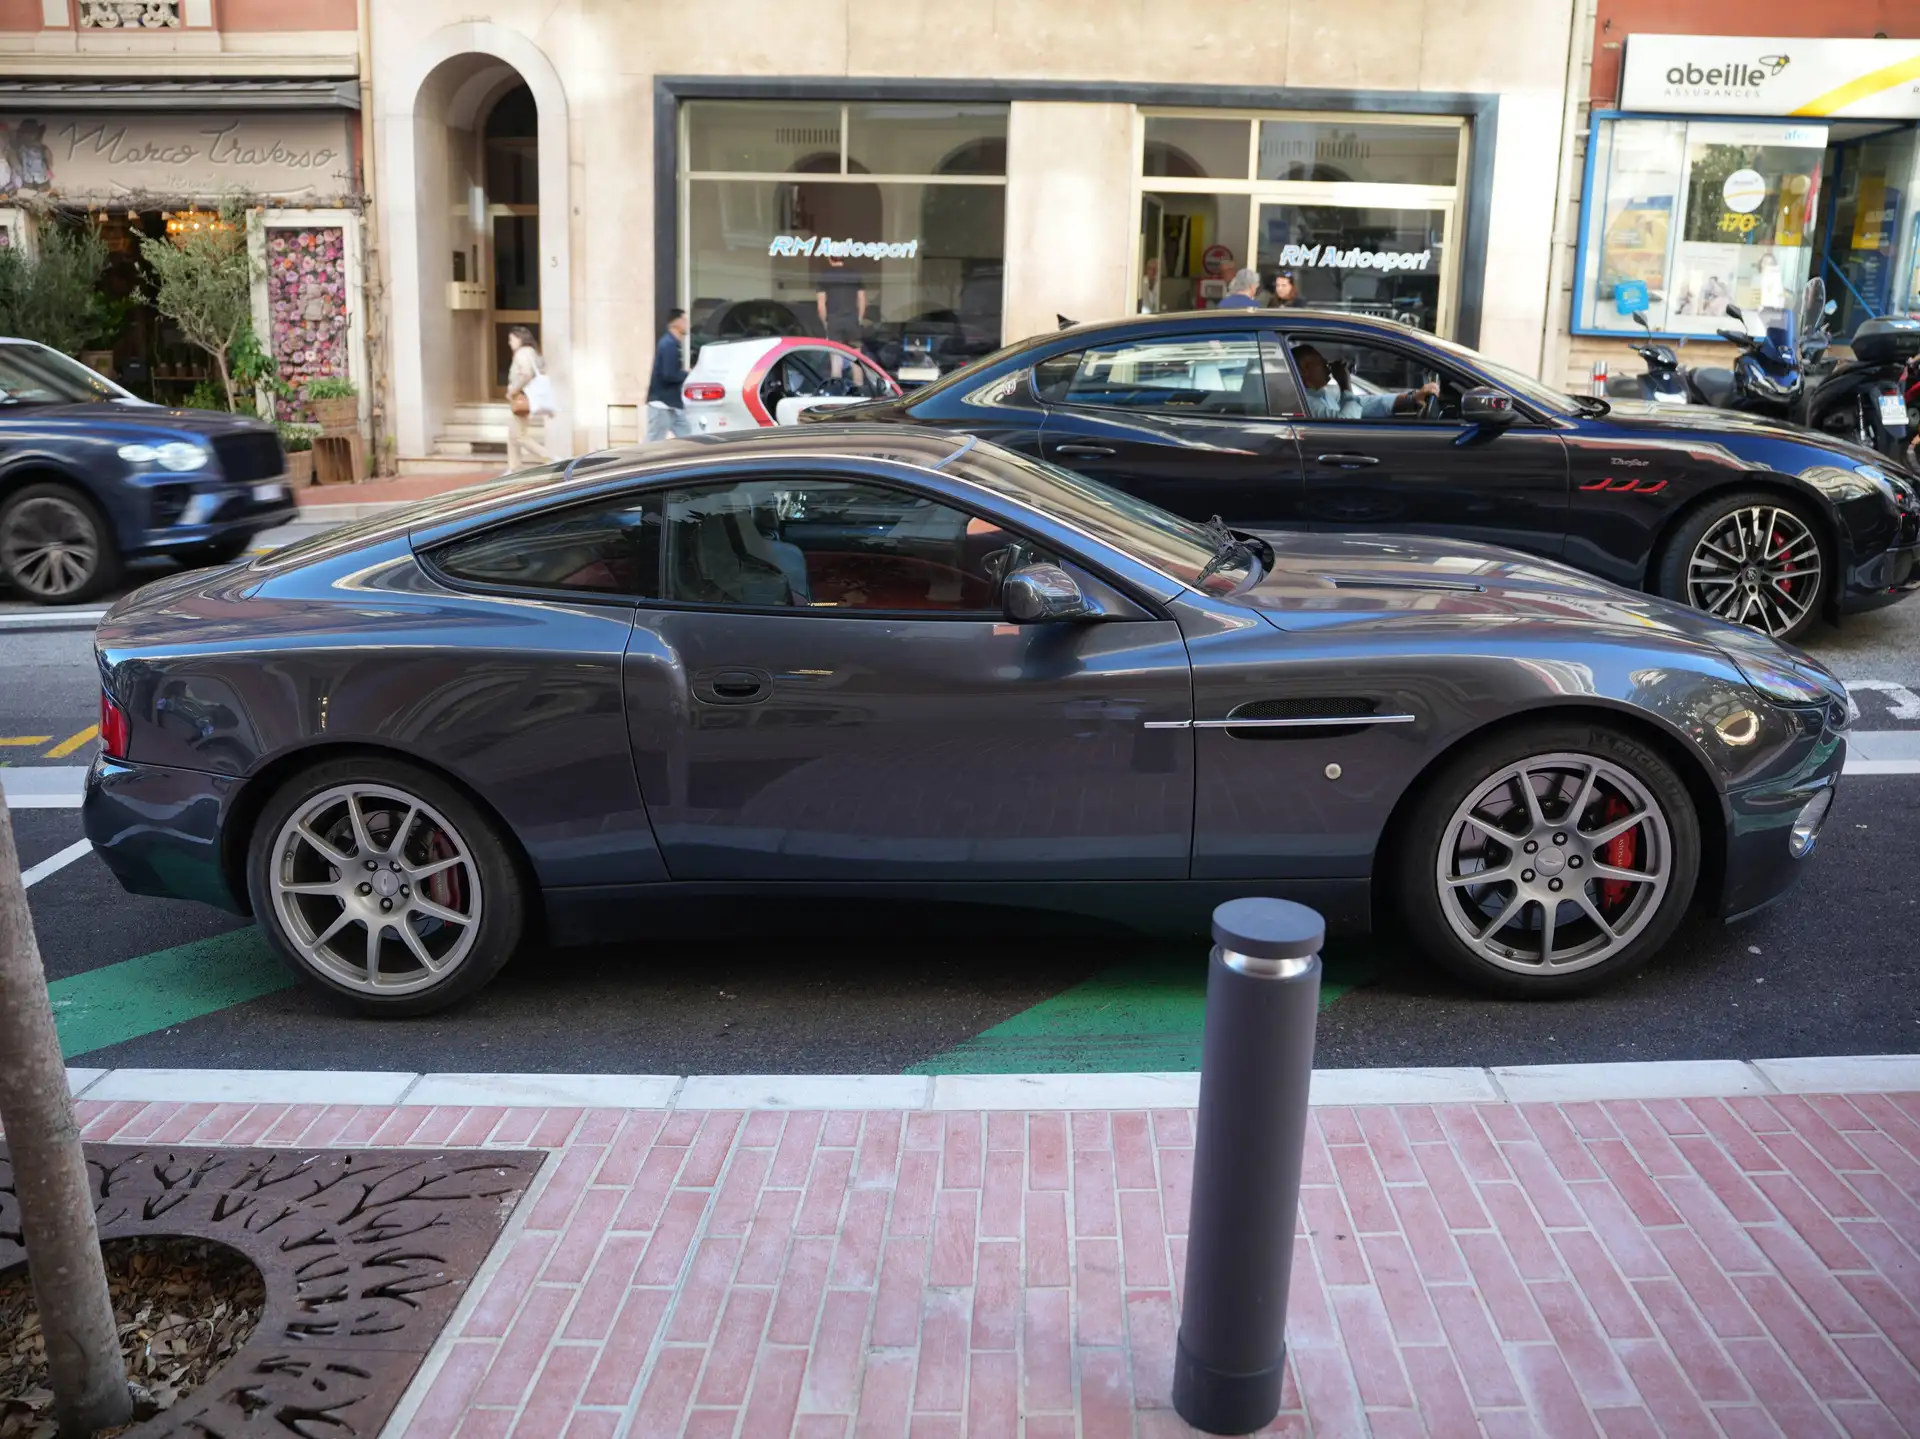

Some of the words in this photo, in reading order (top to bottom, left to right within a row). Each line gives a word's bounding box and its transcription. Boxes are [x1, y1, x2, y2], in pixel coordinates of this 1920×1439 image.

[1666, 62, 1766, 87] abeille
[1663, 87, 1761, 98] ASSURANCES
[59, 121, 200, 164] Marco
[200, 119, 338, 168] Traverso
[768, 235, 817, 256] RM
[814, 237, 918, 261] Autosport
[1279, 243, 1321, 267] RM
[1318, 246, 1431, 273] Autosport
